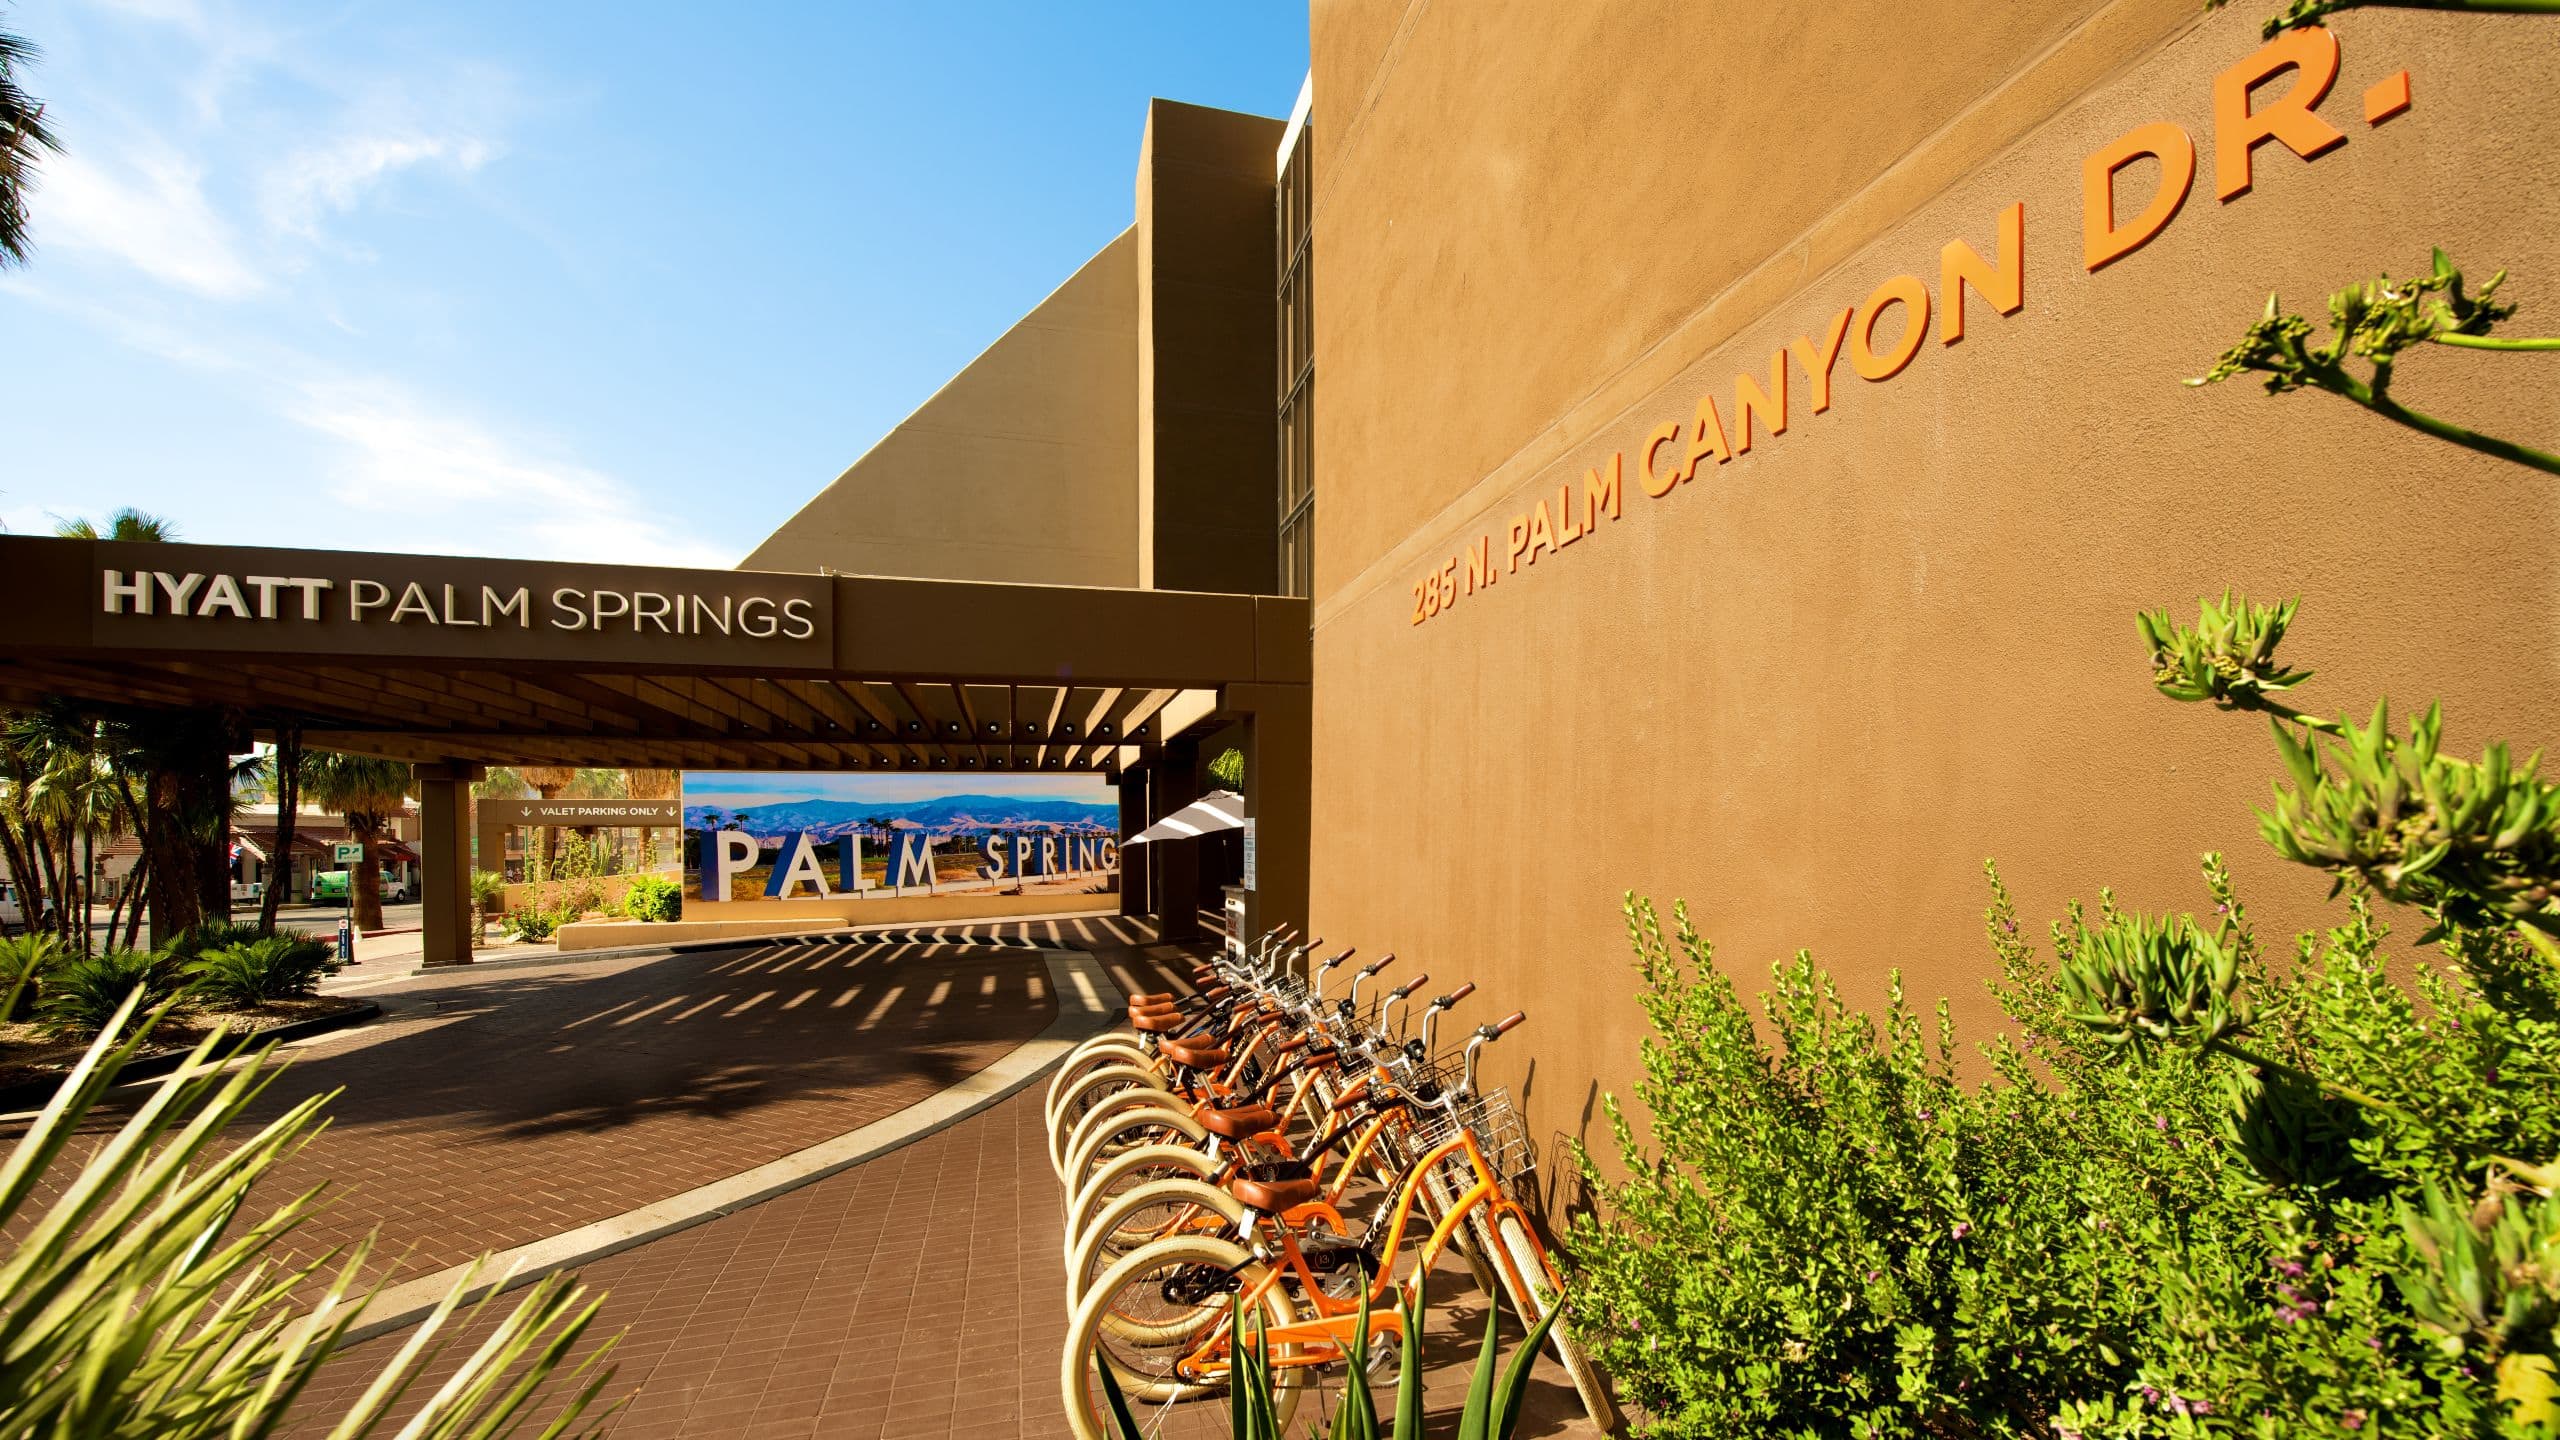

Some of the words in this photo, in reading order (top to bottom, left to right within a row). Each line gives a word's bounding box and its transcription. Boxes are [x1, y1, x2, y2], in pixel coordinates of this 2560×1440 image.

[1410, 555, 1457, 626] 285
[1464, 535, 1498, 595] N.
[1507, 452, 1622, 575] PALM
[1639, 202, 2024, 498] CANYON
[2082, 25, 2412, 274] DR.
[103, 569, 334, 622] HYATT
[350, 579, 530, 629] PALM
[550, 587, 816, 640] SPRINGS
[540, 807, 576, 816] VALET
[578, 807, 627, 816] PARKING
[630, 807, 660, 816] ONLY
[701, 829, 937, 902] PALM
